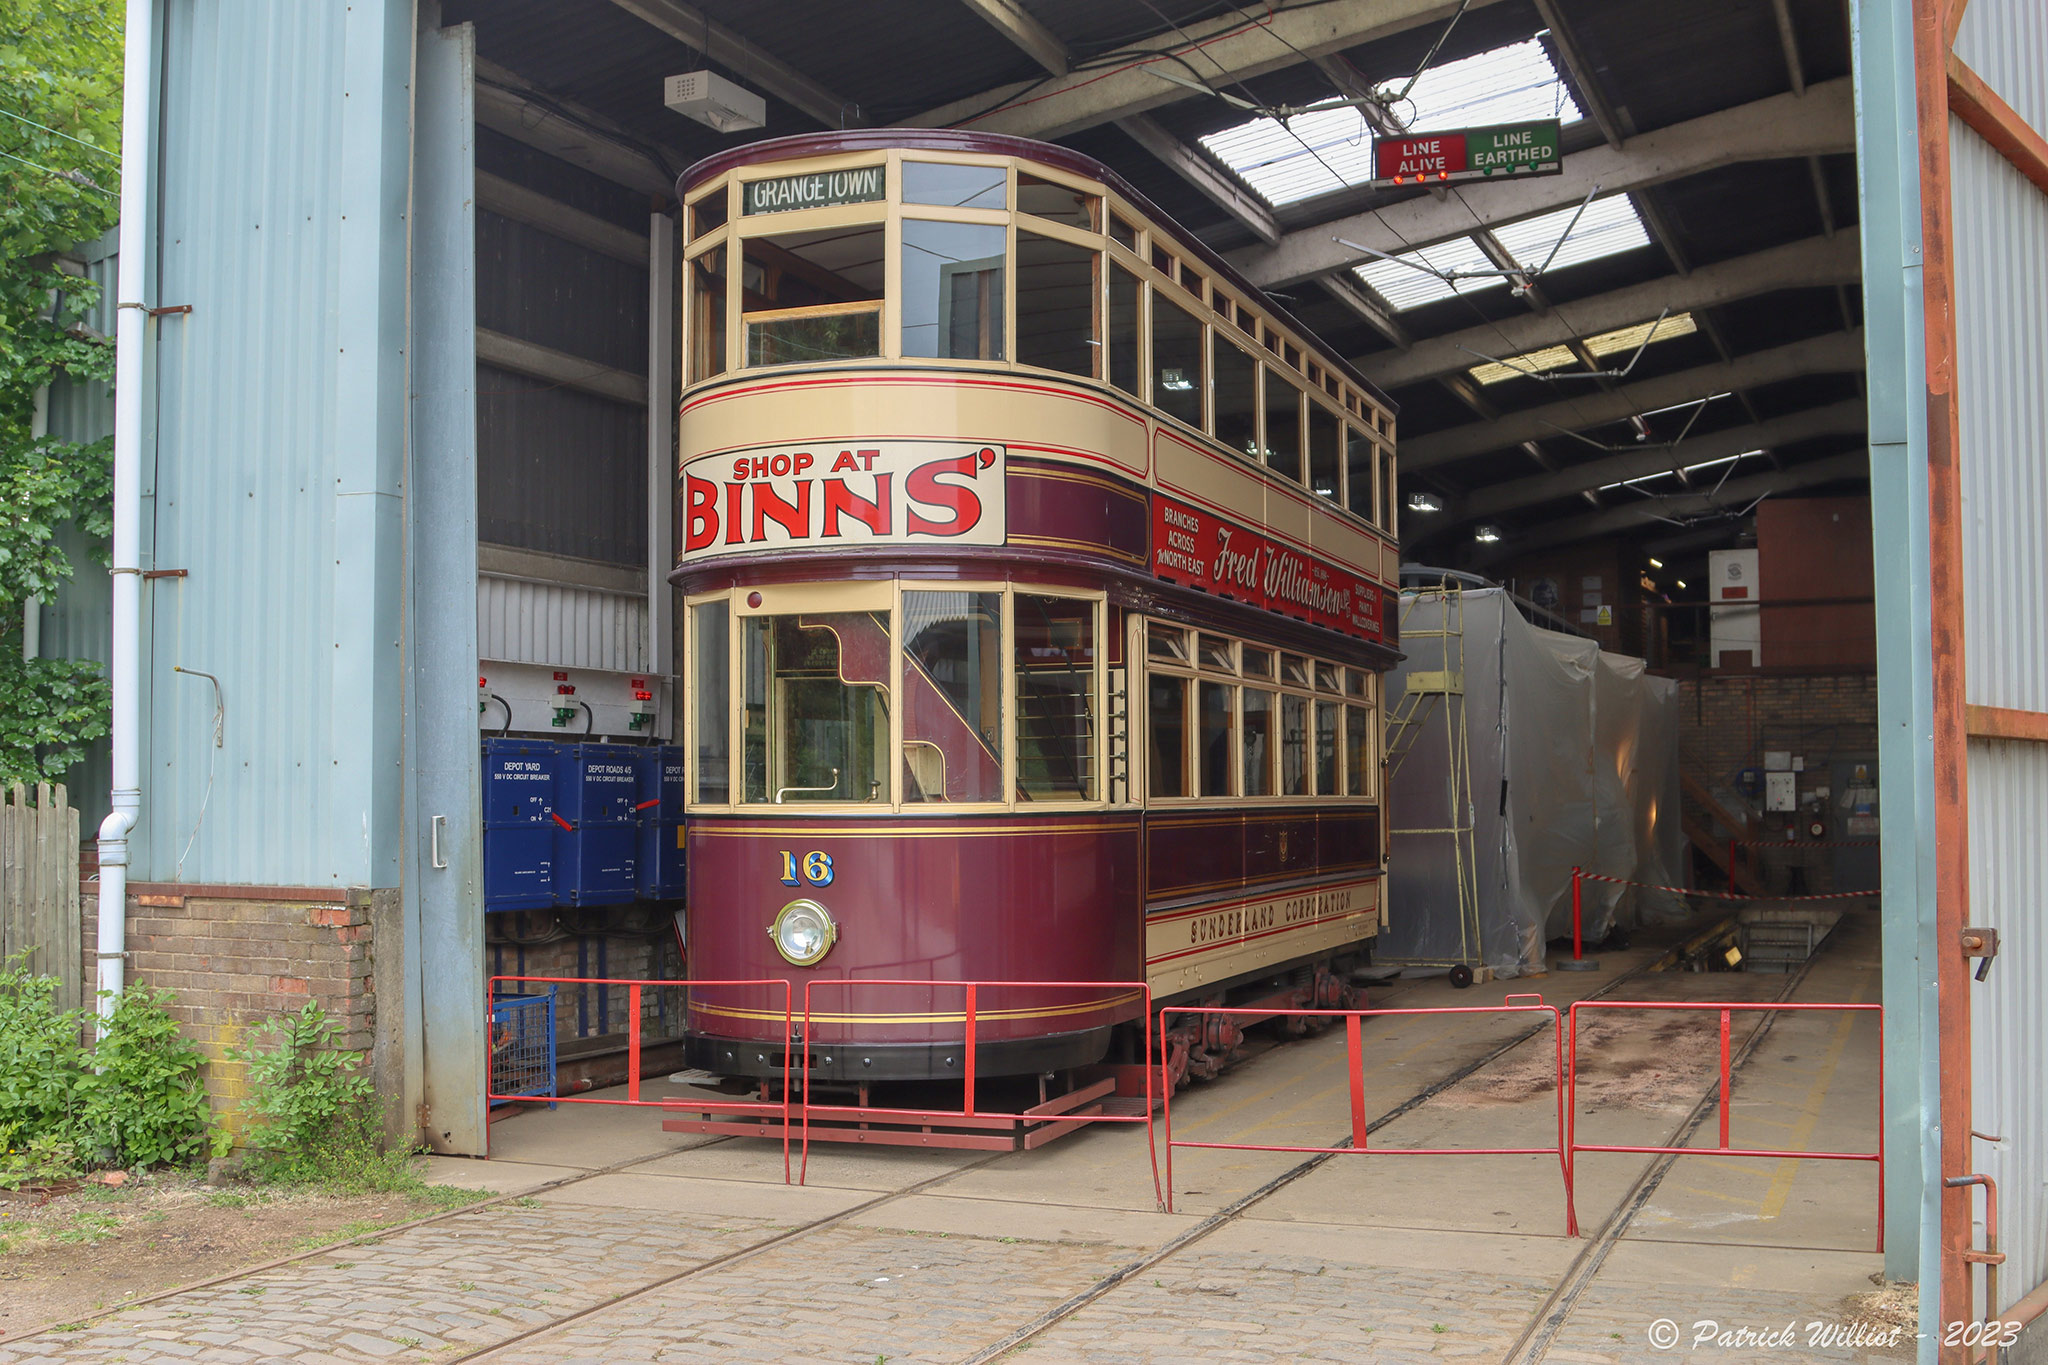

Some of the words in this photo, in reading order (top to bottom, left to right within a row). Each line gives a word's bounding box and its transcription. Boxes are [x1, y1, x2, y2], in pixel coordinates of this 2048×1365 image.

[1403, 141, 1441, 157] LINE
[1493, 131, 1532, 148] LINE
[1399, 157, 1446, 174] ALIVE
[1474, 145, 1553, 167] EARTHED
[753, 168, 877, 208] GRANGETOWN
[733, 452, 815, 481] SHOP
[830, 449, 881, 473] AT
[683, 446, 997, 554] BINNS'
[1164, 506, 1199, 534] BRANCHES
[1168, 530, 1195, 554] ACROSS
[1164, 549, 1187, 571] NORTH
[1188, 556, 1205, 577] EAST
[1213, 527, 1260, 588] Fred
[504, 761, 524, 771] DEPOT
[524, 761, 541, 771] YARD
[530, 773, 550, 781] BREAKER
[587, 764, 605, 773] DEPOT
[605, 765, 624, 774] ROADS
[665, 766, 681, 774] DEPOT
[779, 849, 835, 888] 16
[1190, 904, 1275, 944] SUNDERLAND
[1285, 890, 1352, 923] CORPORATION
